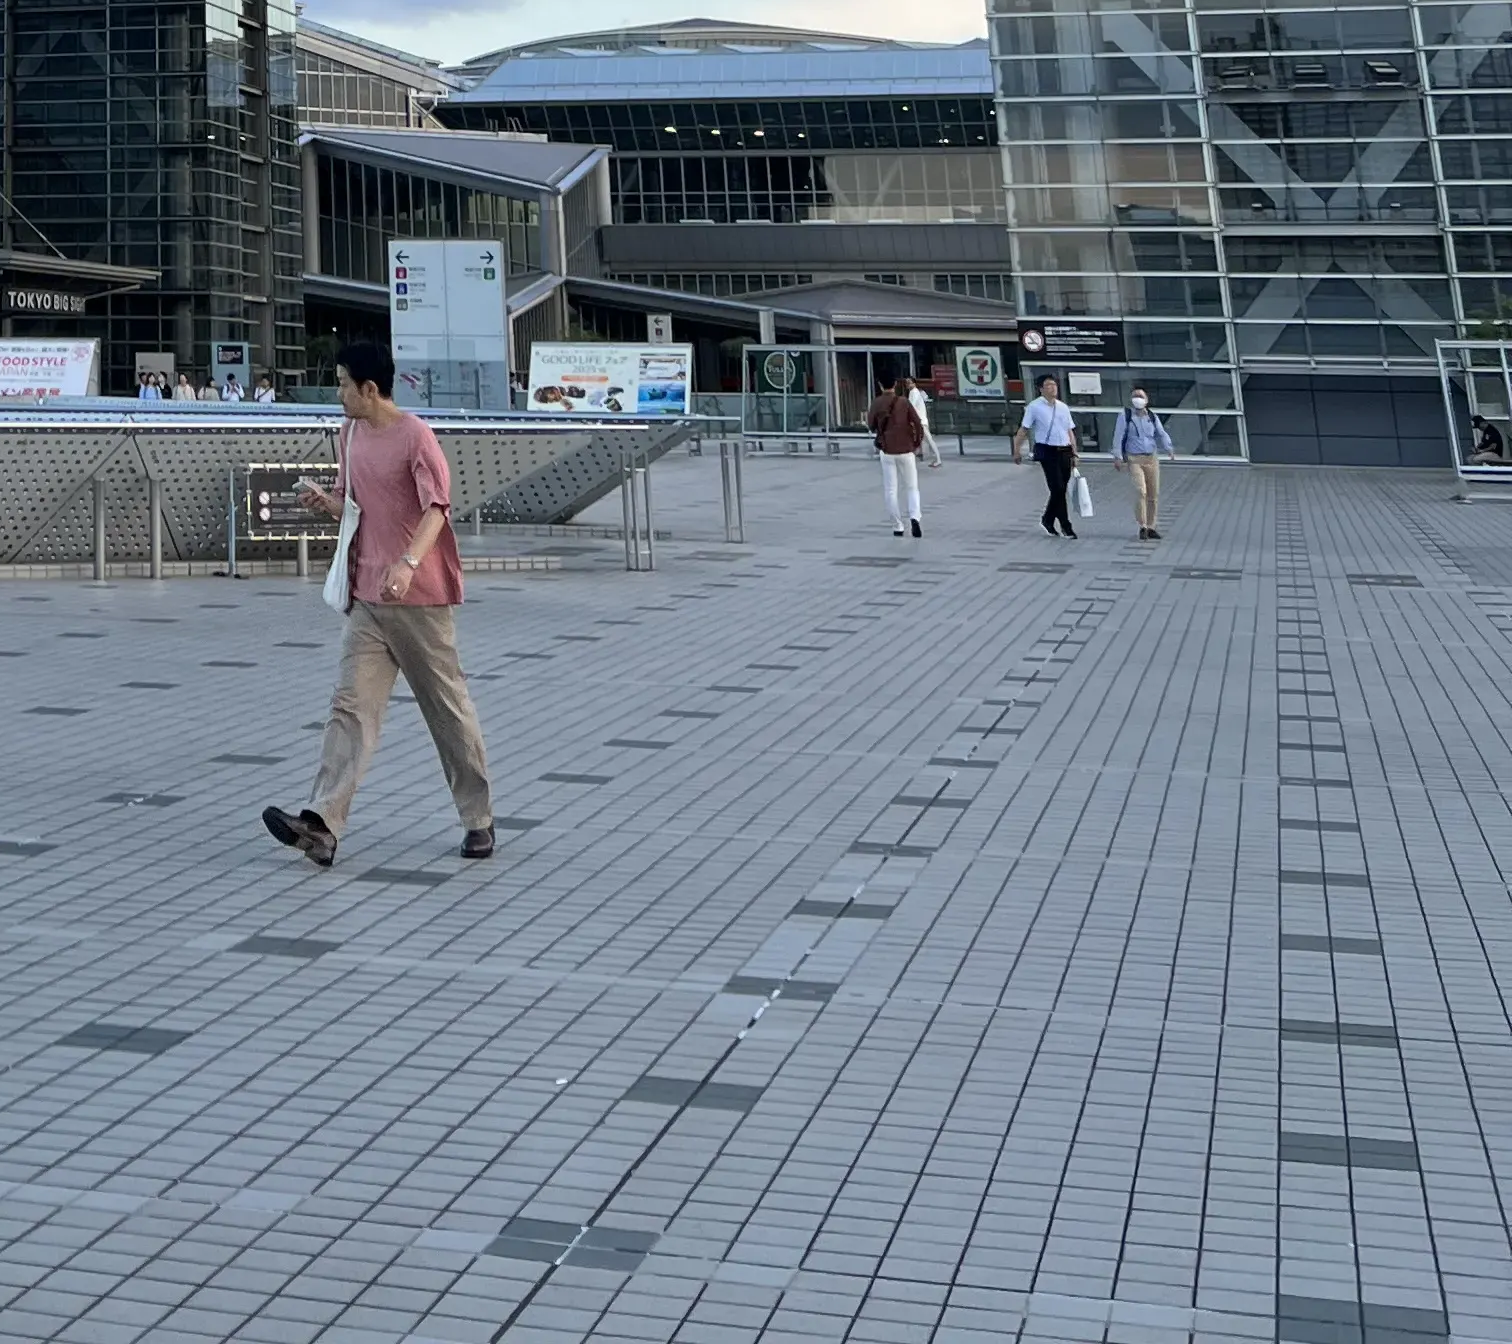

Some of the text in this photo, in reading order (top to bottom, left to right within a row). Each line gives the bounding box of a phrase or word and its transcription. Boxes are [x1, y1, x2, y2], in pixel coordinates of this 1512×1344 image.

[8, 291, 51, 310] TOKYO
[53, 294, 69, 311] BIG
[31, 356, 68, 366] STYLE
[541, 354, 578, 364] GOOD
